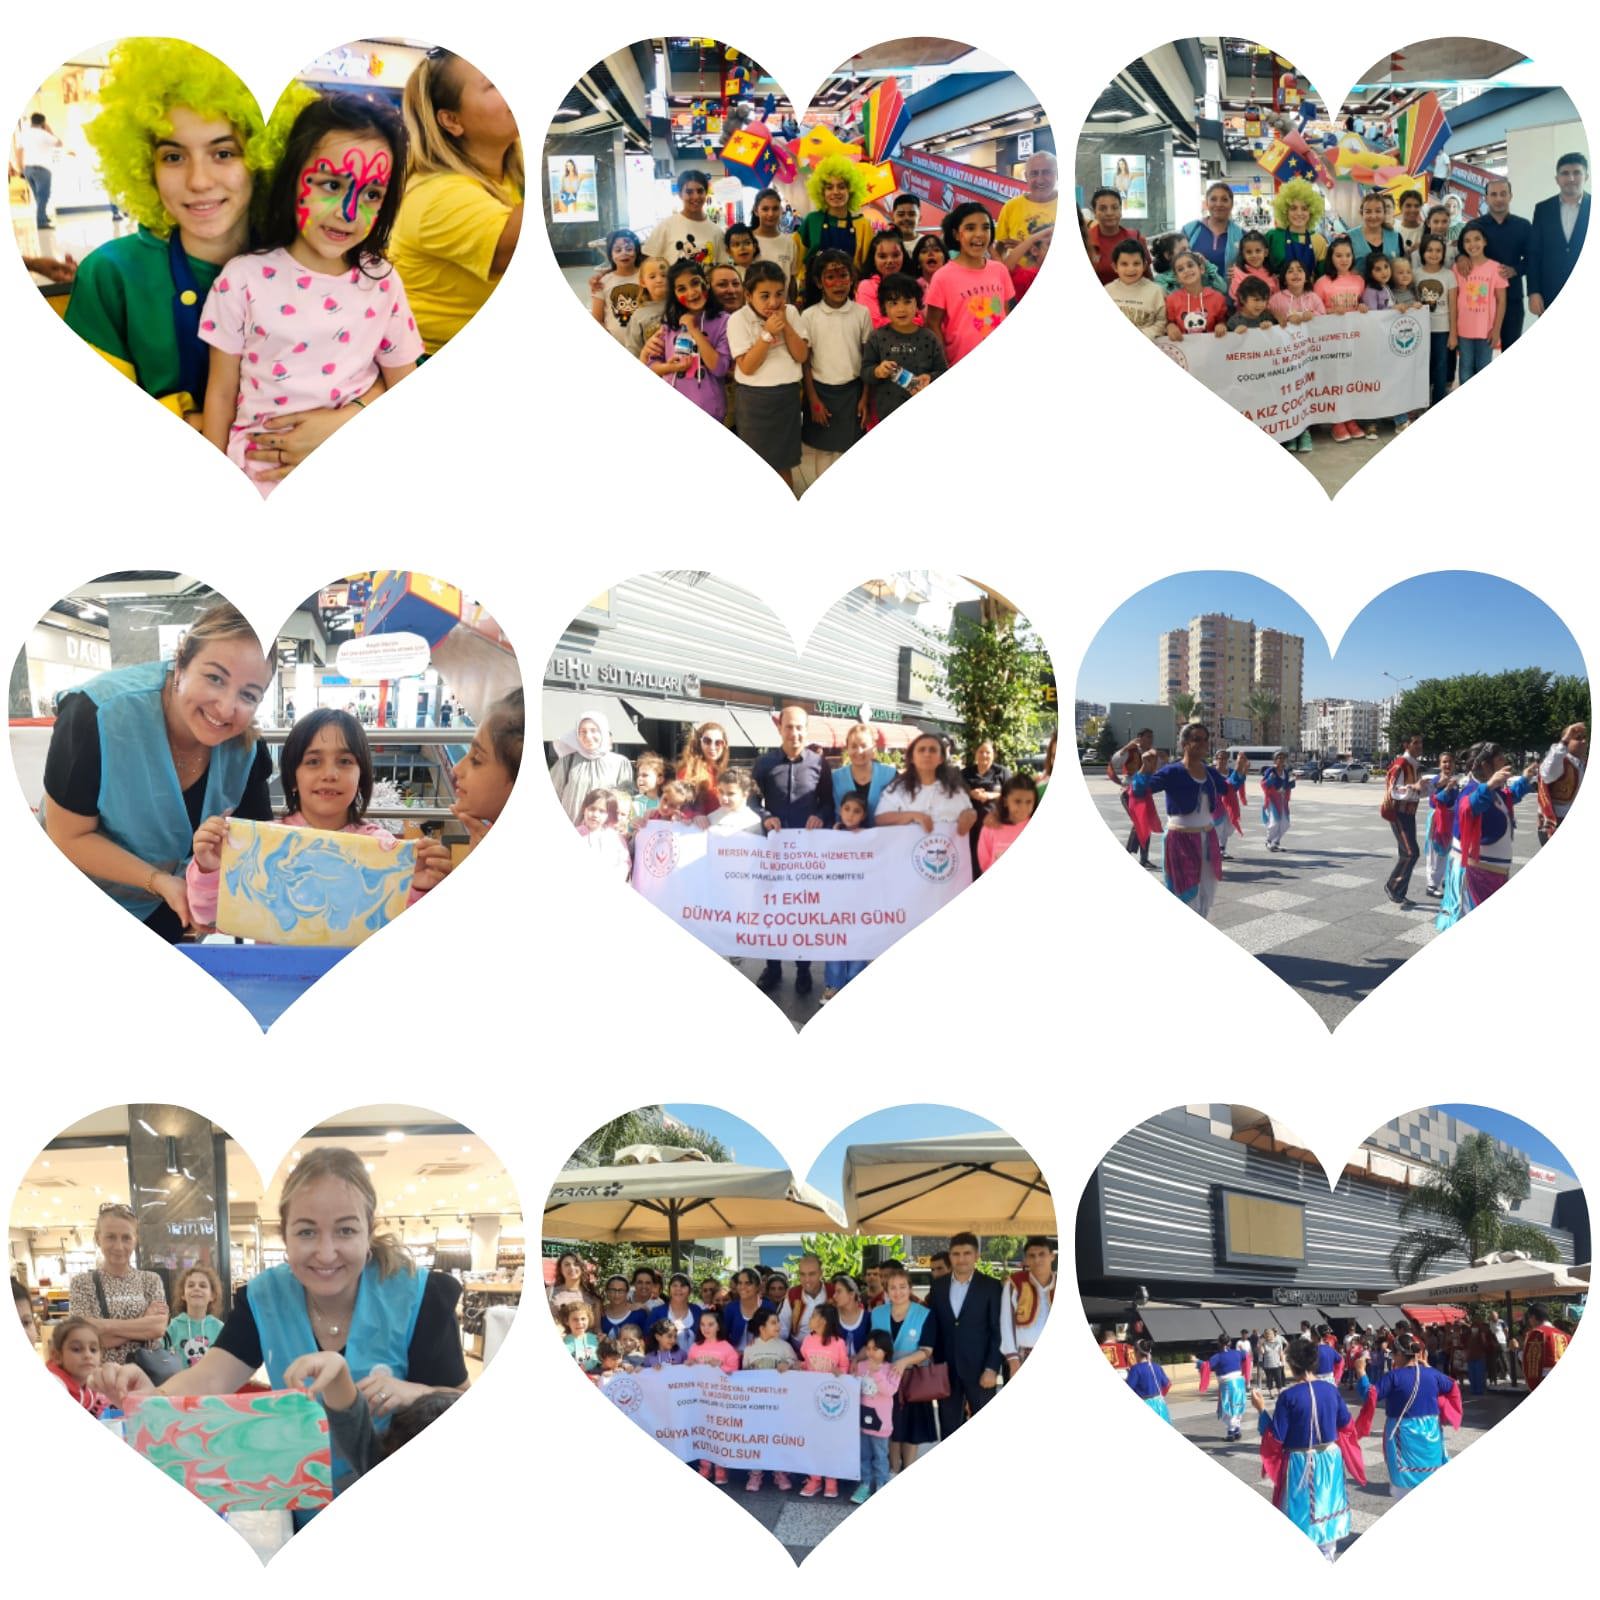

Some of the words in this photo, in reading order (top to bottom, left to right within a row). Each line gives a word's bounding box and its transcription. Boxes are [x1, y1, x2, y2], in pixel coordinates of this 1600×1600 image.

[1280, 384, 1292, 395] 11
[1256, 404, 1278, 420] KIZ
[1281, 385, 1344, 414] ÇOCKLARI
[1346, 380, 1381, 393] GÜNÜ
[783, 851, 819, 860] SOSYAL
[821, 850, 874, 861] HİZMETLER
[795, 872, 824, 882] ÇOCUK
[763, 893, 778, 905] 11
[782, 889, 821, 905] EKİM
[682, 905, 732, 923] DÜNYA
[736, 912, 759, 926] KIZ
[763, 911, 856, 928] ÇOCUKLARI
[860, 908, 907, 926] GÜNÜ
[736, 932, 787, 946] KUTLU
[792, 932, 848, 946] OLSUN
[716, 1414, 743, 1428] EKİM
[655, 1427, 689, 1440] DÜNYA
[772, 1432, 806, 1448] GÜNÜ
[720, 1447, 762, 1460] OLSUN
